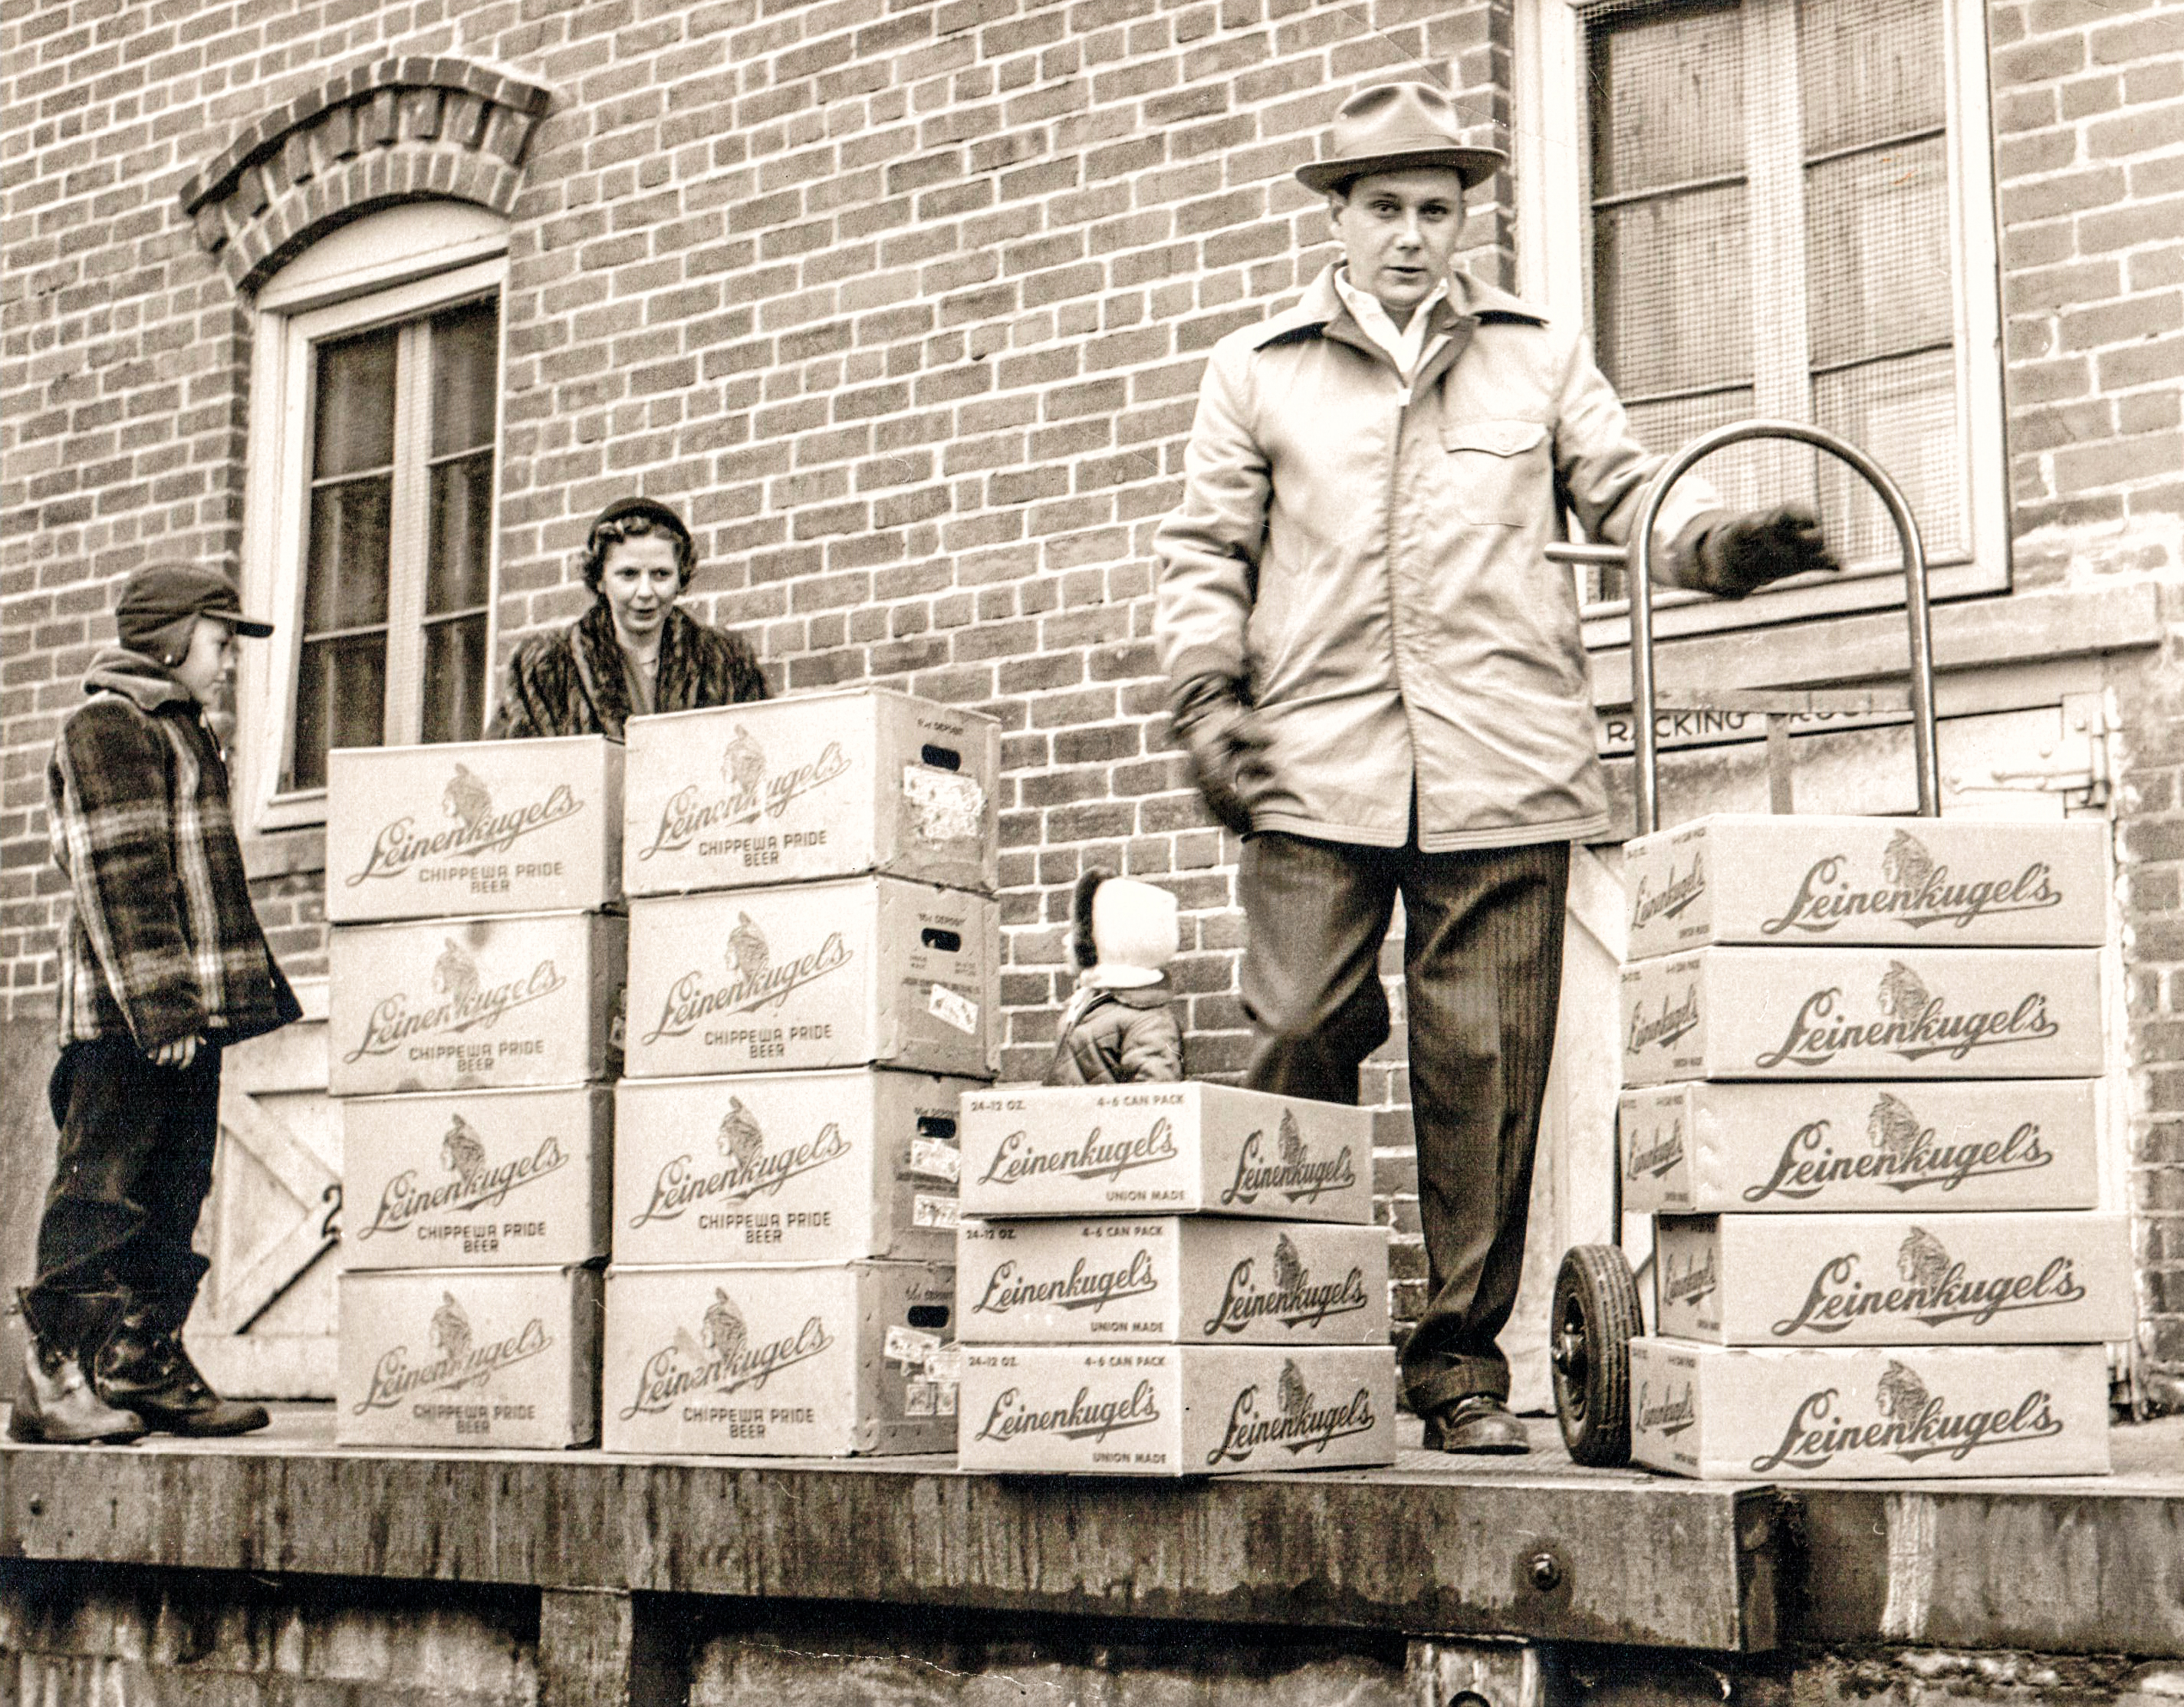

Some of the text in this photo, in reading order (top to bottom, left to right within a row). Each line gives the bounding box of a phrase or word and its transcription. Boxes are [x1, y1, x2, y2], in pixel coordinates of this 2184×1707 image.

[1606, 711, 1751, 745] RCKING
[346, 784, 584, 887] Leinenkugel's
[699, 830, 827, 857] CHIPPEWA PRIDE
[744, 851, 779, 867] BEER
[419, 862, 564, 883] CHIPPEWA PRIDE
[470, 879, 510, 893] BEER
[1761, 854, 2063, 935] Leinenkugel's
[641, 932, 853, 1046] Leinenkugel's
[705, 1025, 832, 1046] CHIPPEWA PRIDE
[1755, 987, 2060, 1068] Leinenkugel's
[409, 1040, 544, 1061] CHIPPEWA PRIDE
[749, 1044, 784, 1057] BEER
[457, 1057, 495, 1072] BEER
[971, 1101, 1002, 1111] 24-12
[1097, 1094, 1185, 1107] 4-6 CAN PACK
[977, 1117, 1179, 1186] Leinenkugel's
[1743, 1119, 2053, 1202] Leinenkugel's
[630, 1123, 851, 1228] Leinenkugel's
[1220, 1129, 1356, 1205] Leinenkugel's
[357, 1136, 569, 1240] Leinenkugel's
[1106, 1189, 1186, 1202] UNION MADE
[699, 1212, 831, 1228] CHIPPEWA PRIDE
[417, 1222, 546, 1240] CHIPPEWA PRIDE
[745, 1230, 782, 1244] BEER
[1106, 1226, 1130, 1237] CAN
[1134, 1225, 1163, 1236] PACK
[463, 1240, 499, 1253] BEER
[972, 1249, 1158, 1314] Leinenkugel's
[1203, 1257, 1367, 1336] Leinenkugel's
[1771, 1253, 2086, 1337] Leinenkugel's
[1090, 1321, 1163, 1332] UNION MADE
[353, 1319, 553, 1416] Leinenugel's
[620, 1317, 834, 1419] Leinenkugel's
[1109, 1356, 1133, 1367] CAN
[1136, 1356, 1166, 1367] PACK
[413, 1405, 535, 1419] CHIPPEWA PRIDE
[683, 1407, 814, 1422] CHIPPEWA PRIDE
[975, 1379, 1160, 1444] Leinenkugel's
[456, 1420, 491, 1434] BEER
[729, 1424, 766, 1438] BEER
[1206, 1383, 1375, 1465] Leinenkugel's
[1751, 1389, 2064, 1472] Leinenkugel's
[1093, 1452, 1166, 1464] UNION MADE
